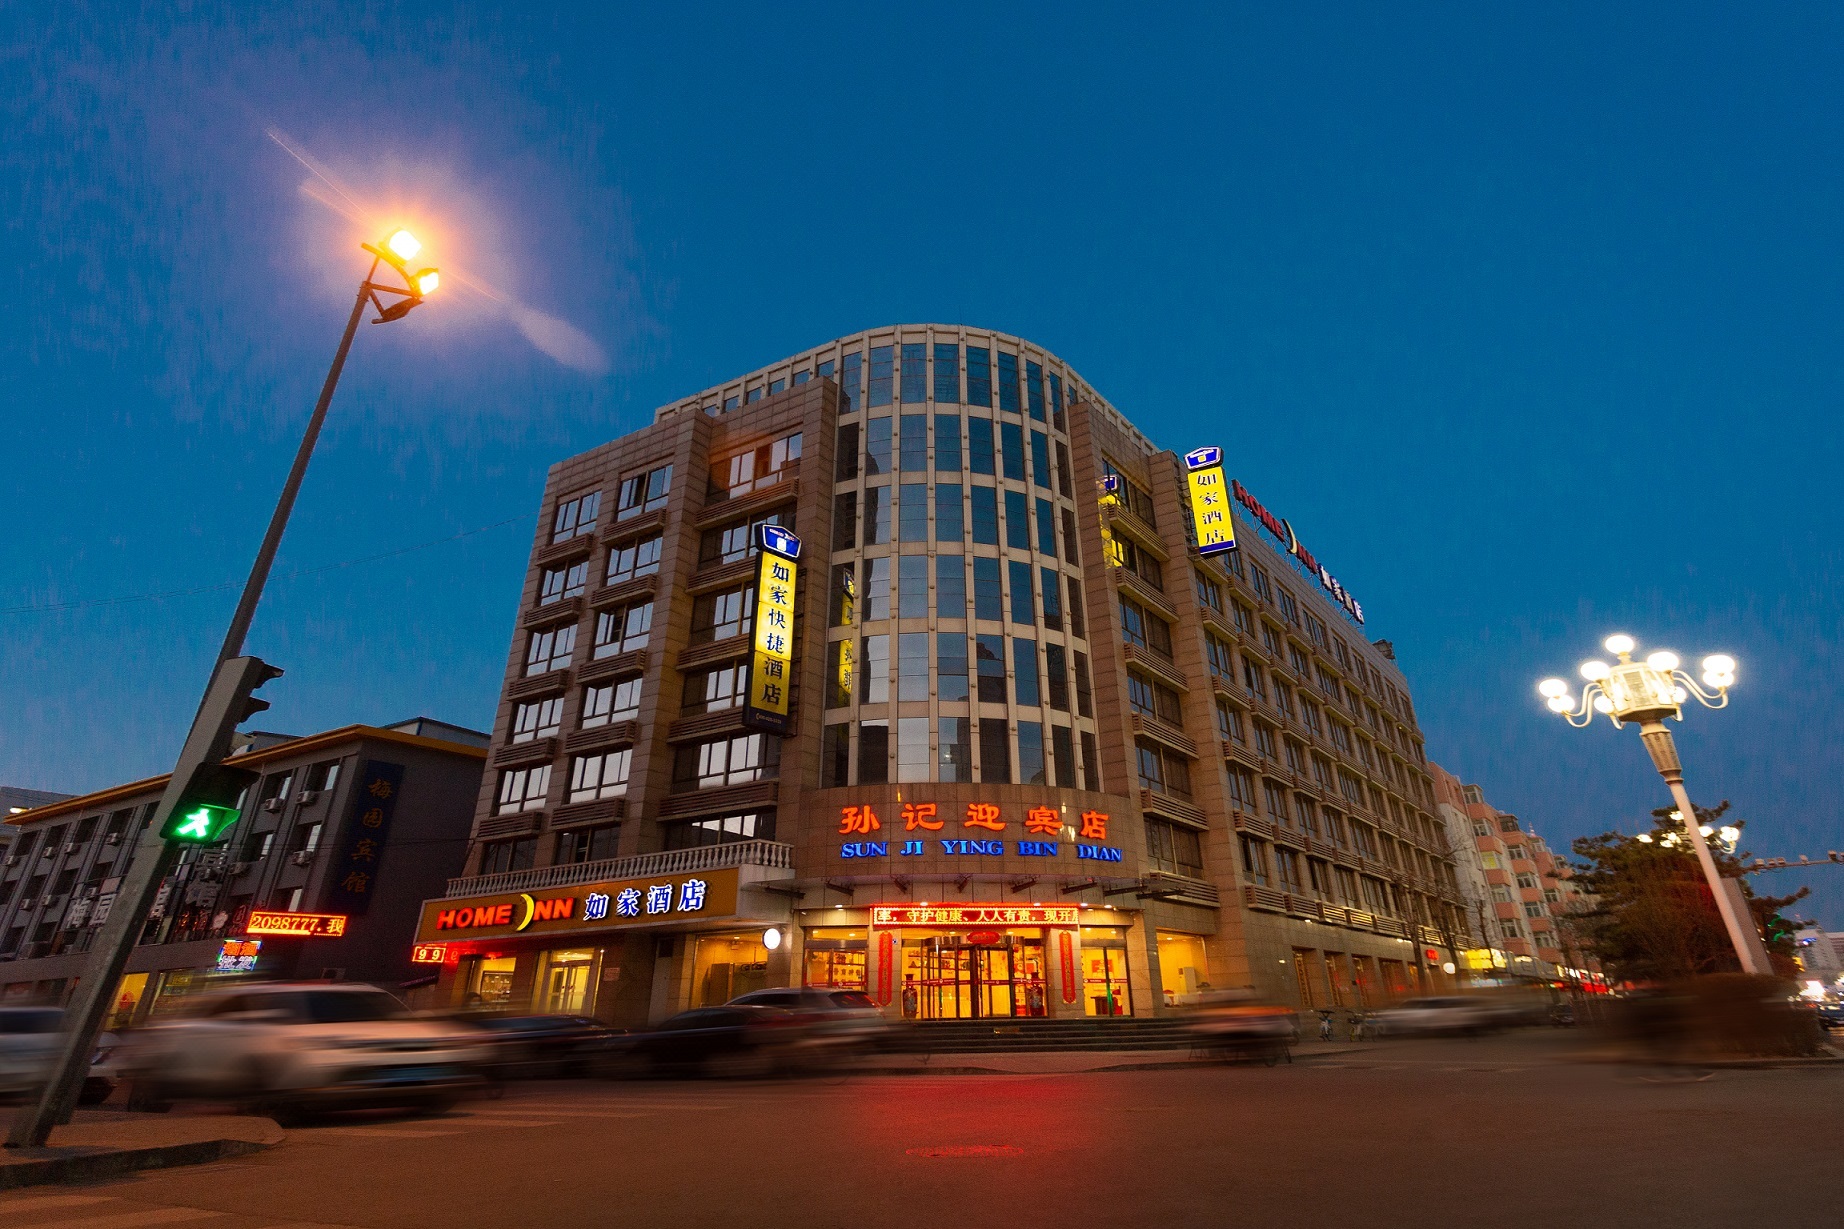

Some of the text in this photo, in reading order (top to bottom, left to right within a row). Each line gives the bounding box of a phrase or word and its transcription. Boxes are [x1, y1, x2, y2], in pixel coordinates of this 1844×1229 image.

[1231, 479, 1285, 542] HOME
[761, 562, 789, 706] 如家快捷酒店
[341, 778, 394, 893] 梅园宾馆
[839, 803, 1109, 840] 孙记迎宾店
[840, 840, 1123, 863] SUN JI YING BIN DIAN
[436, 903, 513, 930] HOME
[583, 879, 707, 921] 如家酒店
